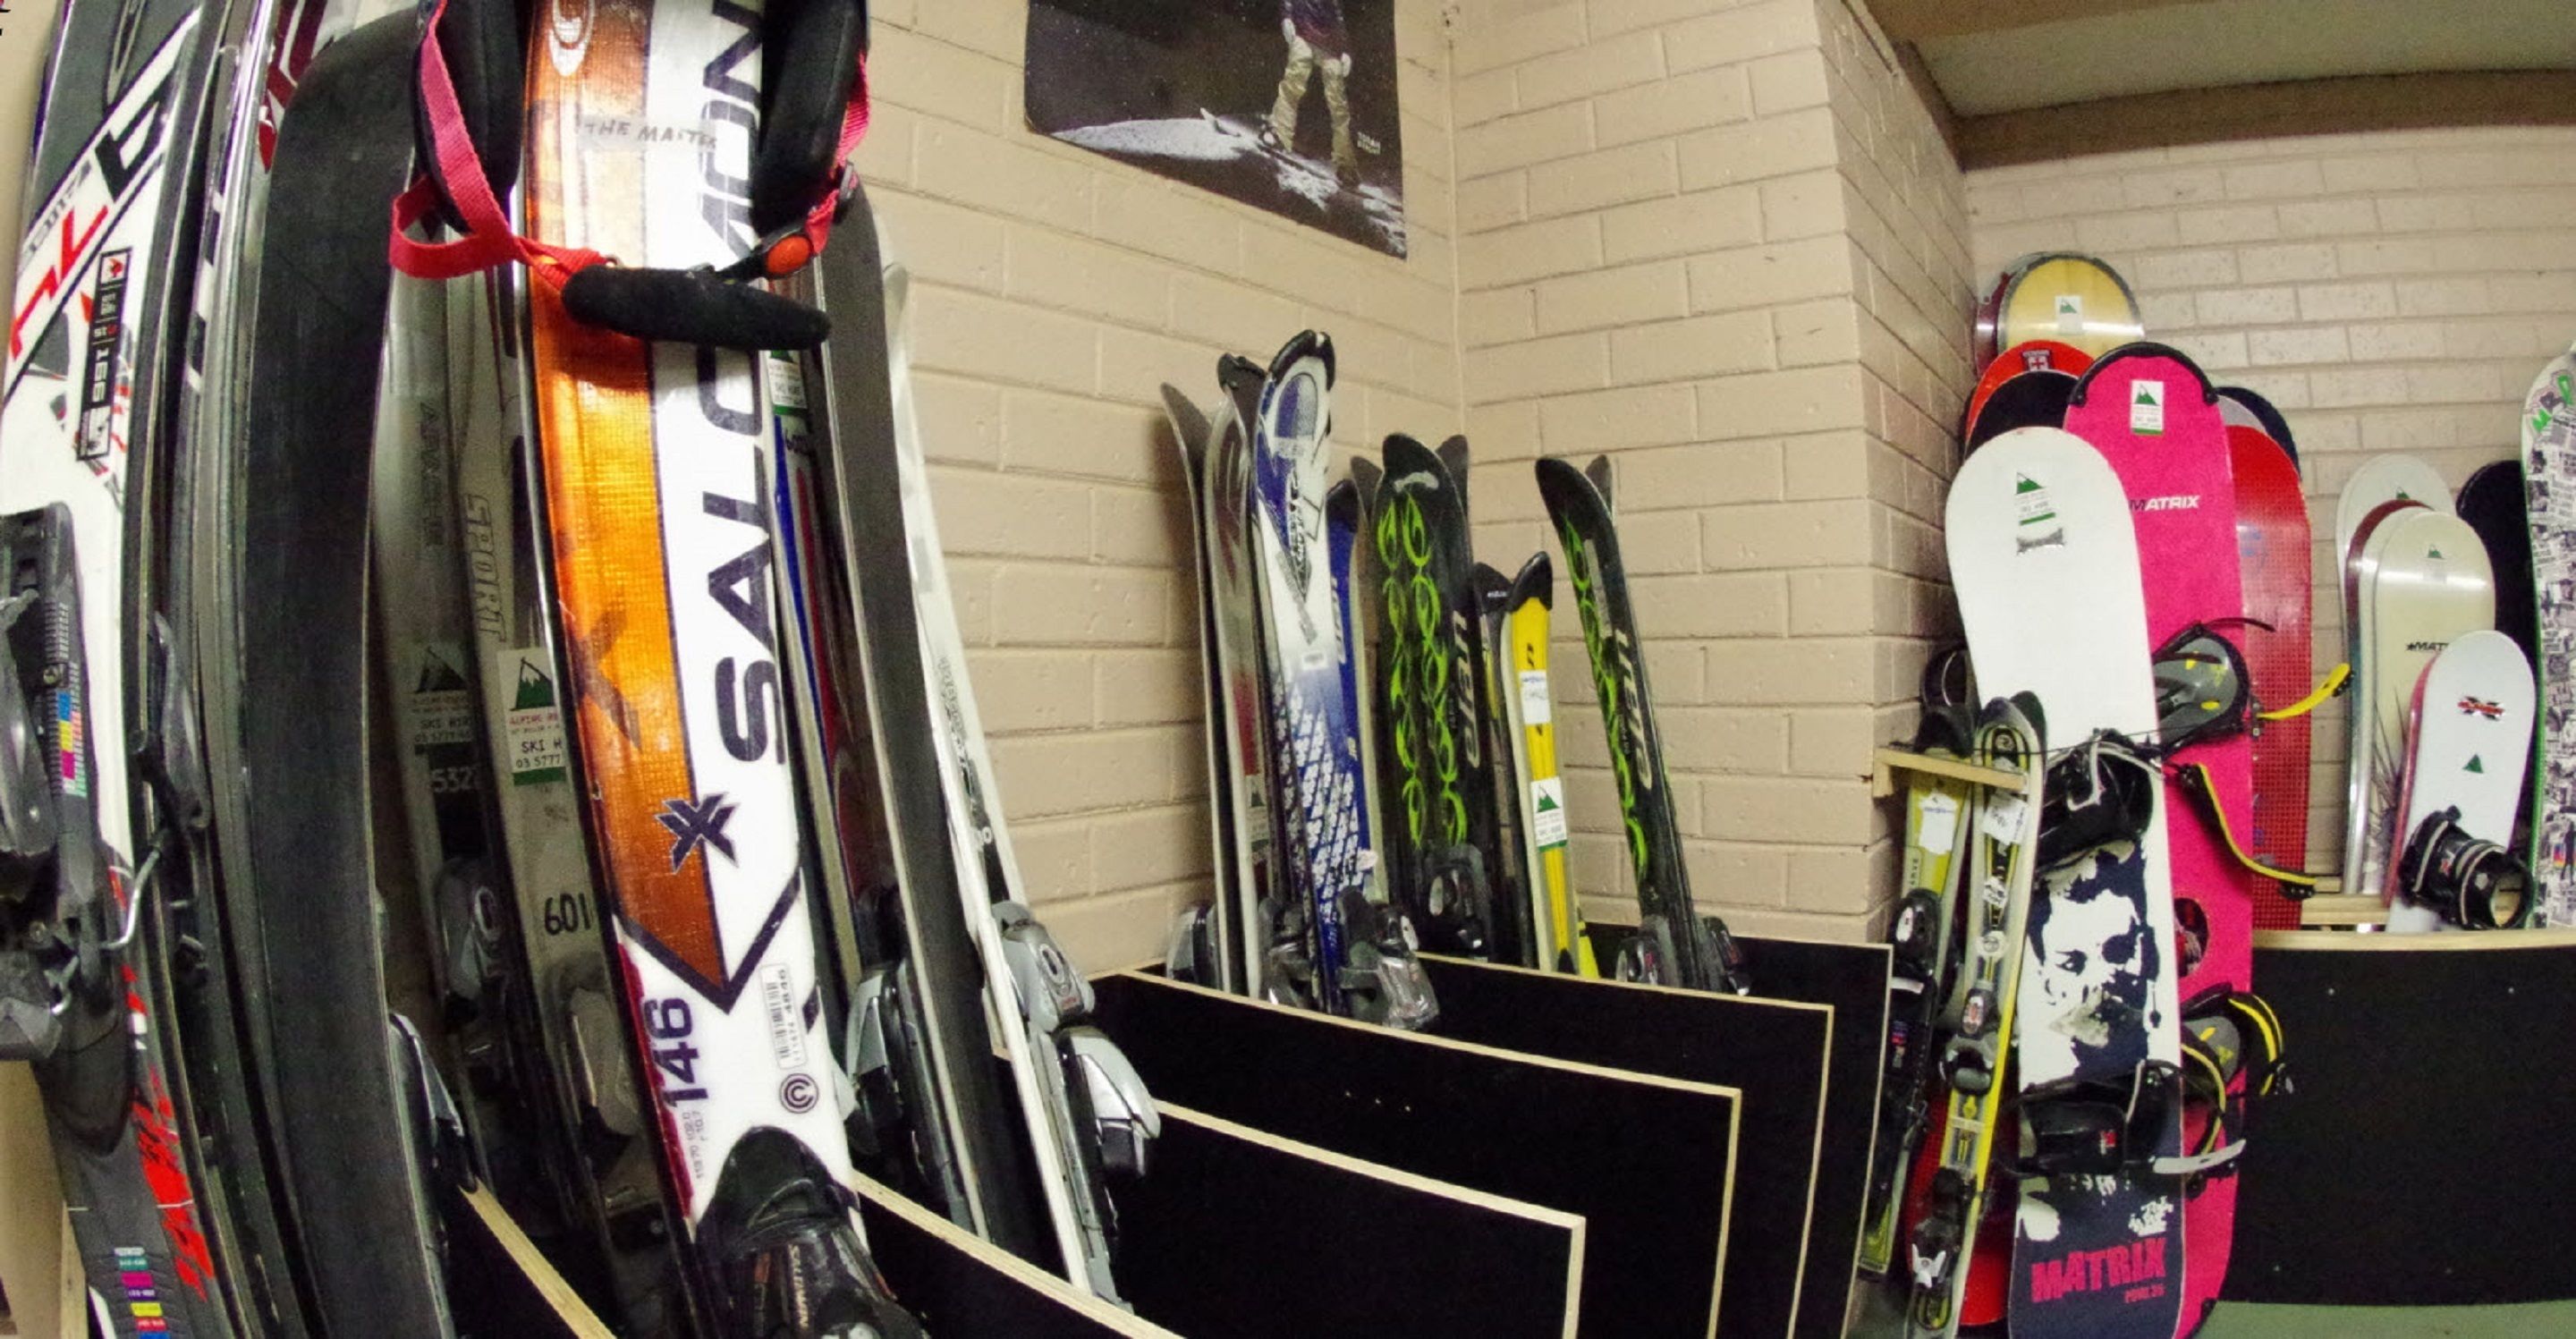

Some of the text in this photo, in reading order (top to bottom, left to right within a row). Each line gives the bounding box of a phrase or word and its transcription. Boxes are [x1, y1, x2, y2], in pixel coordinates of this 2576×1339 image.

[585, 119, 631, 135] THE
[2130, 495, 2201, 512] MATRIX
[466, 494, 507, 643] SPORT
[521, 738, 547, 755] SKI
[516, 757, 531, 769] 03
[545, 892, 591, 936] 601
[643, 997, 708, 1107] 146
[2031, 1236, 2167, 1303] MATRIX
